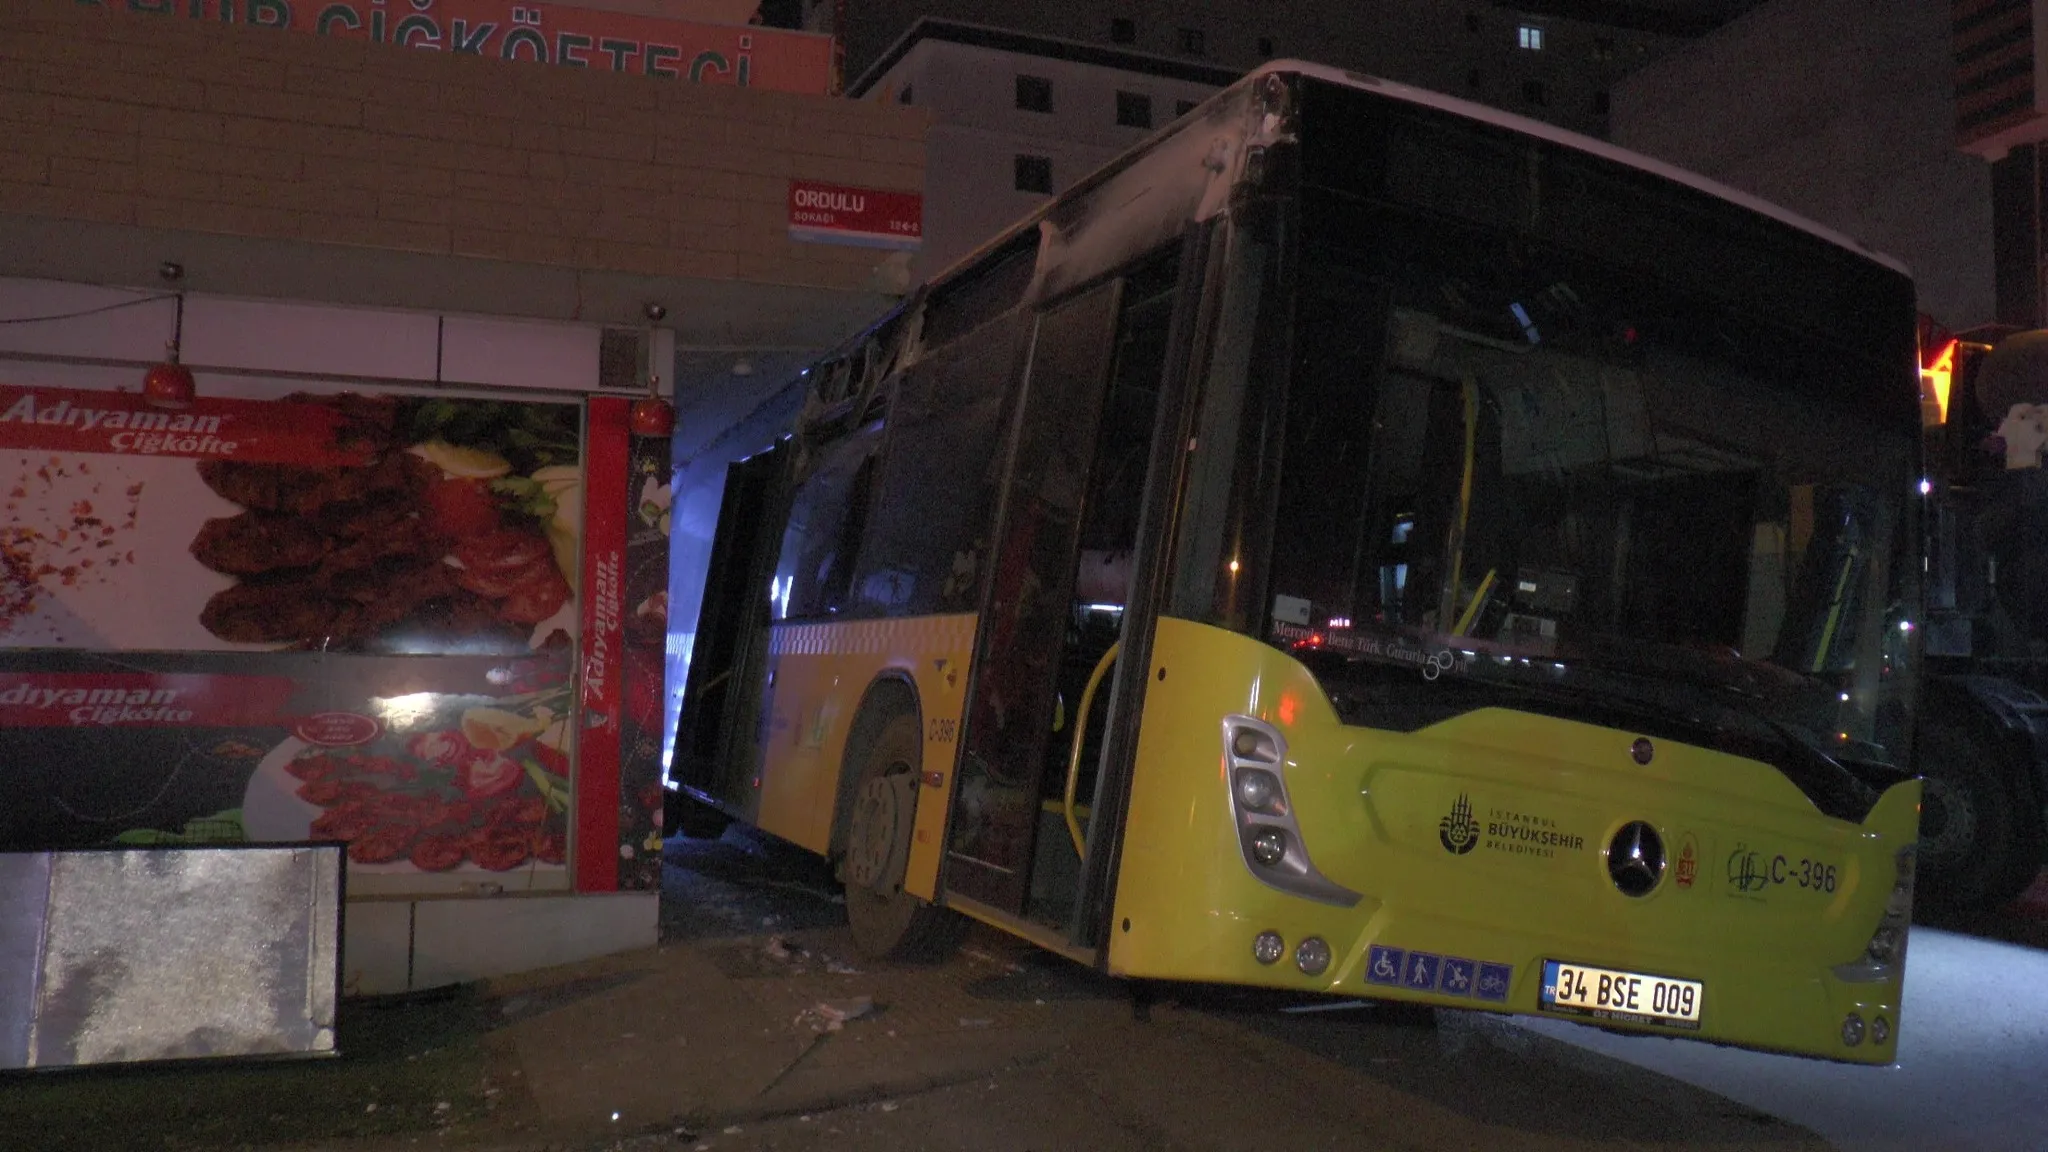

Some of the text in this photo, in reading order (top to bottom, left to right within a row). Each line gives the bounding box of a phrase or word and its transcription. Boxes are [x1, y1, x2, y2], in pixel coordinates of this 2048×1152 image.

[794, 189, 865, 213] ORDULU
[1357, 636, 1380, 654] Türk
[1423, 650, 1454, 681] 50
[928, 718, 955, 742] C-396
[1487, 822, 1584, 850] BÜYÜKŞEHİR
[1772, 855, 1837, 893] C-396
[1545, 985, 1556, 995] TR
[1558, 969, 1695, 1017] 34 BSE 009
